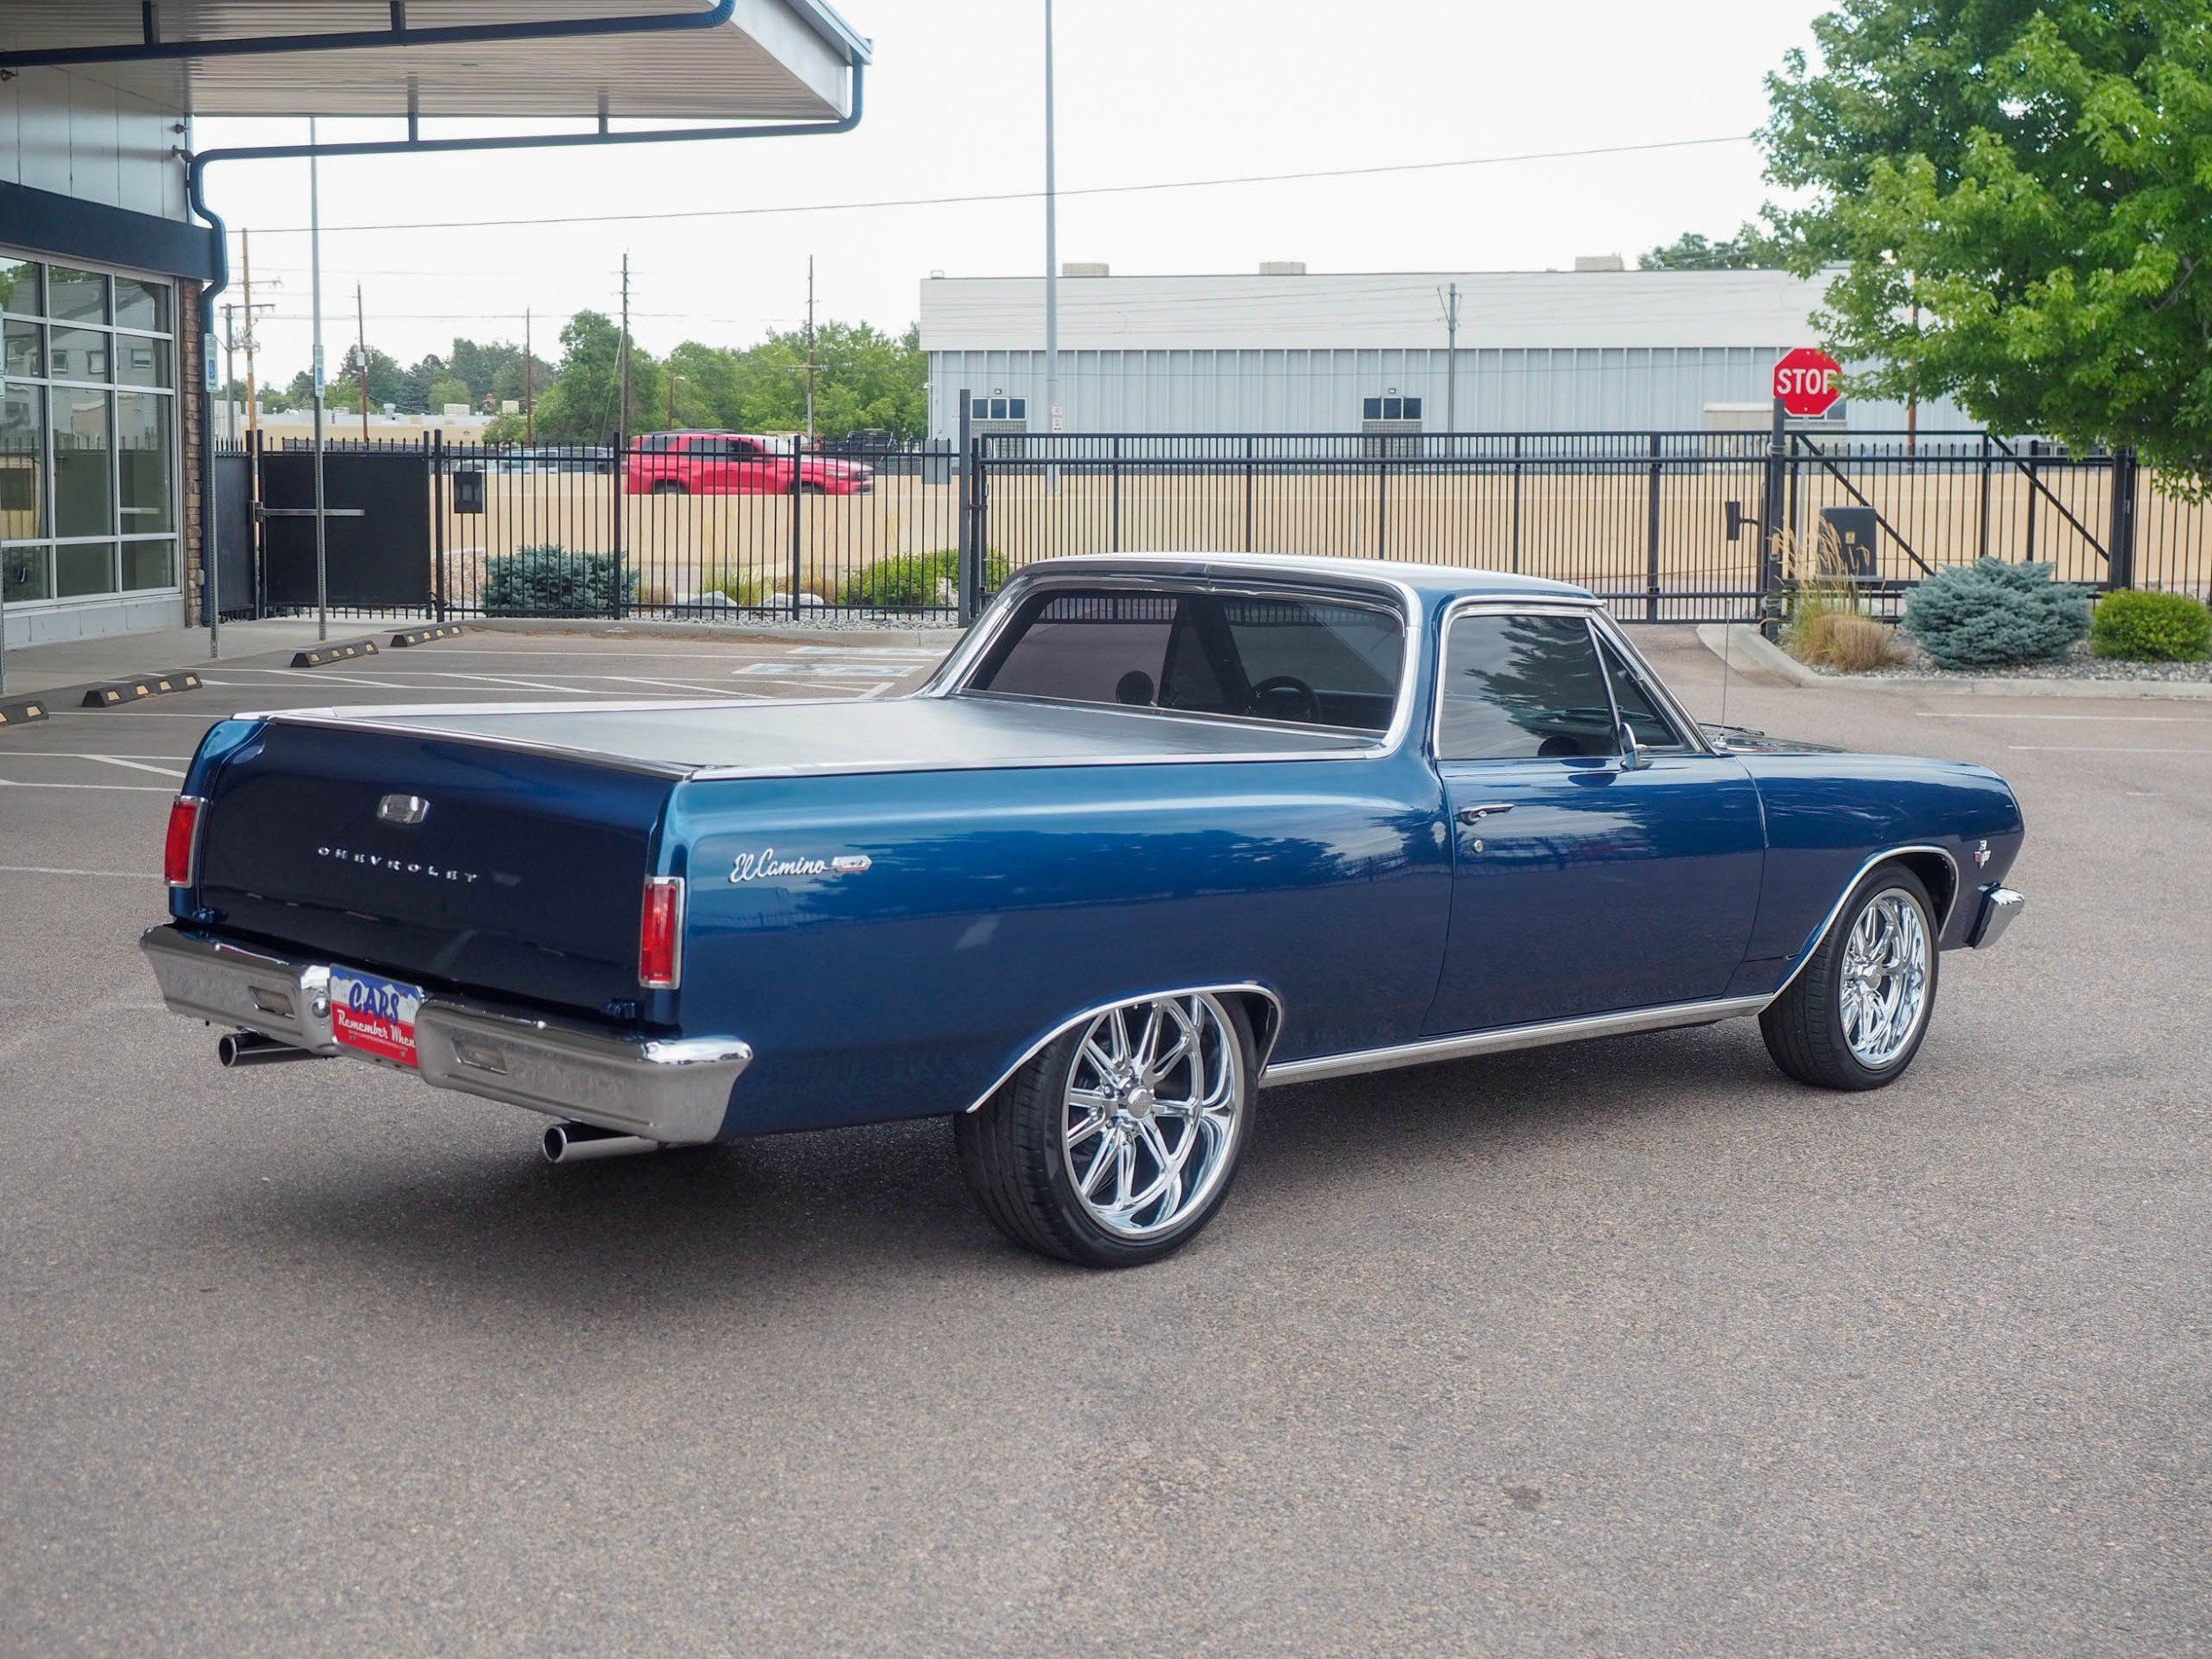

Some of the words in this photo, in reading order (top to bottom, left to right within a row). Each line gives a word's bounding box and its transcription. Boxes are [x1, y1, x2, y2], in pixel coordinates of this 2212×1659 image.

[1777, 368, 1838, 395] STOP
[317, 846, 478, 883] CHEVROLET
[729, 852, 755, 883] El
[754, 848, 828, 879] Camino
[349, 981, 400, 1025] CARS
[337, 1009, 388, 1039] Remember
[389, 1025, 416, 1048] When
